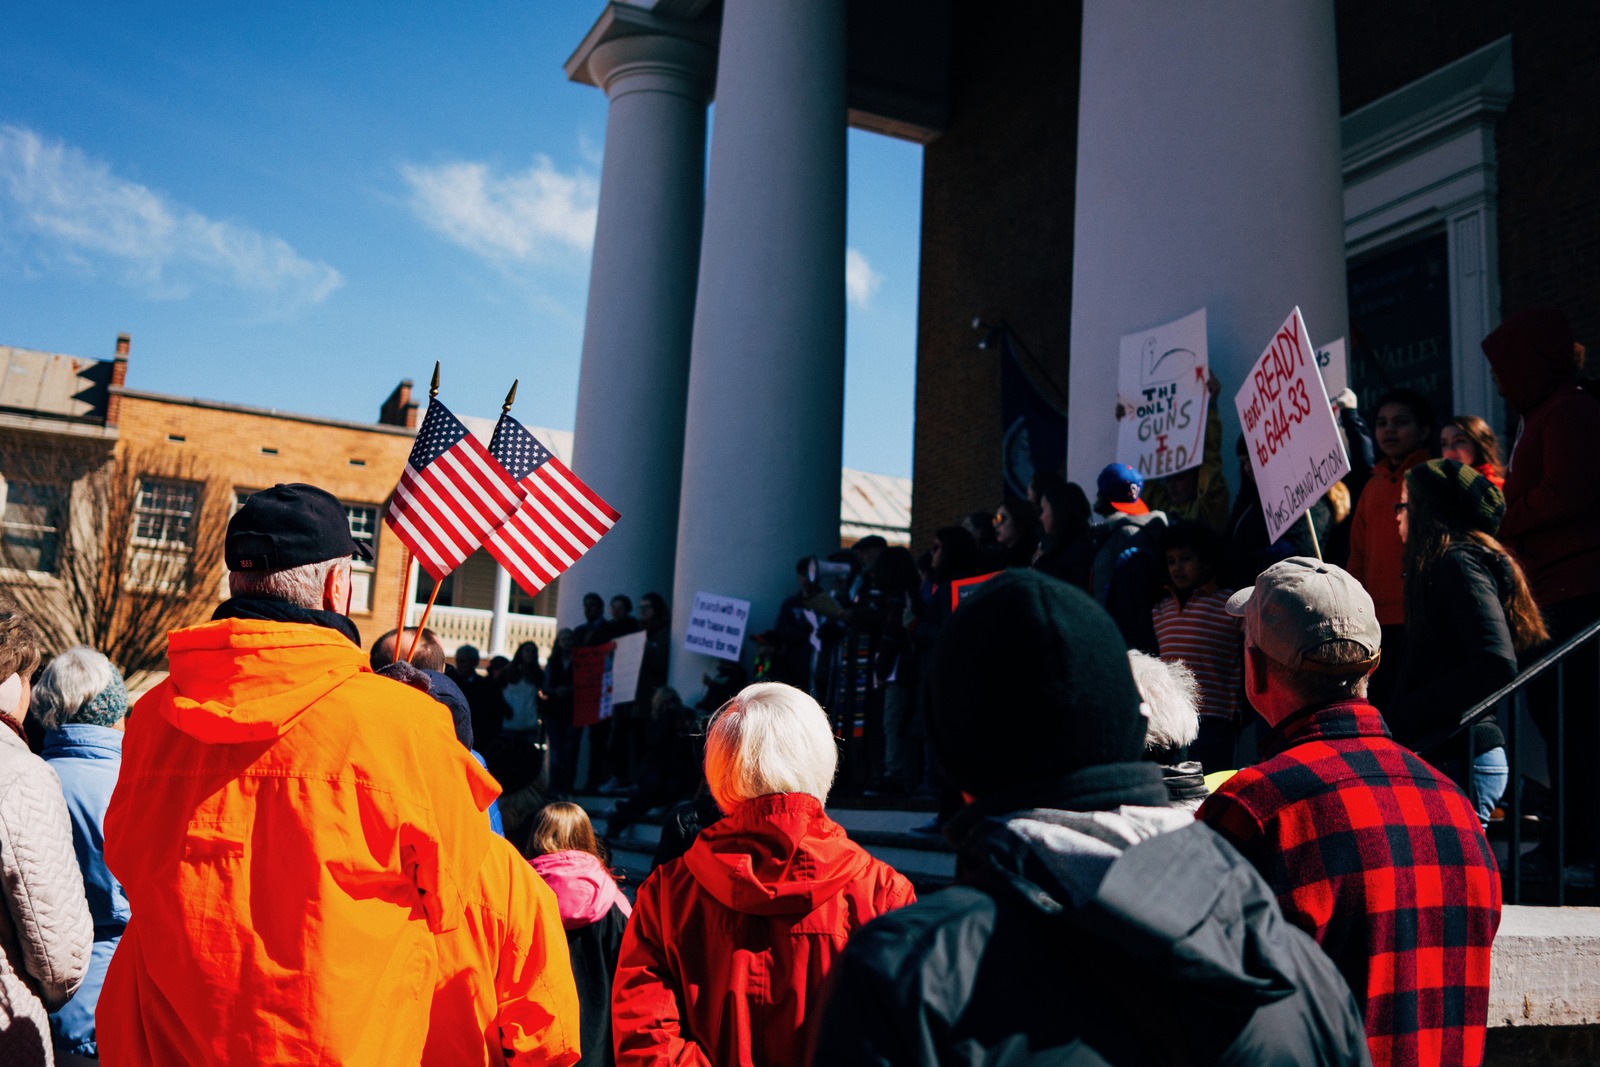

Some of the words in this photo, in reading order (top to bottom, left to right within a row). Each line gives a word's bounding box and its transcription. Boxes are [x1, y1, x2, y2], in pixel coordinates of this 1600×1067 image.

[1243, 392, 1262, 433] text
[1254, 313, 1305, 412] READY
[1136, 395, 1175, 418] ONLY
[1142, 383, 1177, 402] THE
[1137, 400, 1193, 443] GUNS
[1255, 438, 1269, 469] to
[1264, 377, 1312, 456] 644-33
[1155, 434, 1169, 454] I
[1138, 445, 1188, 476] NEED
